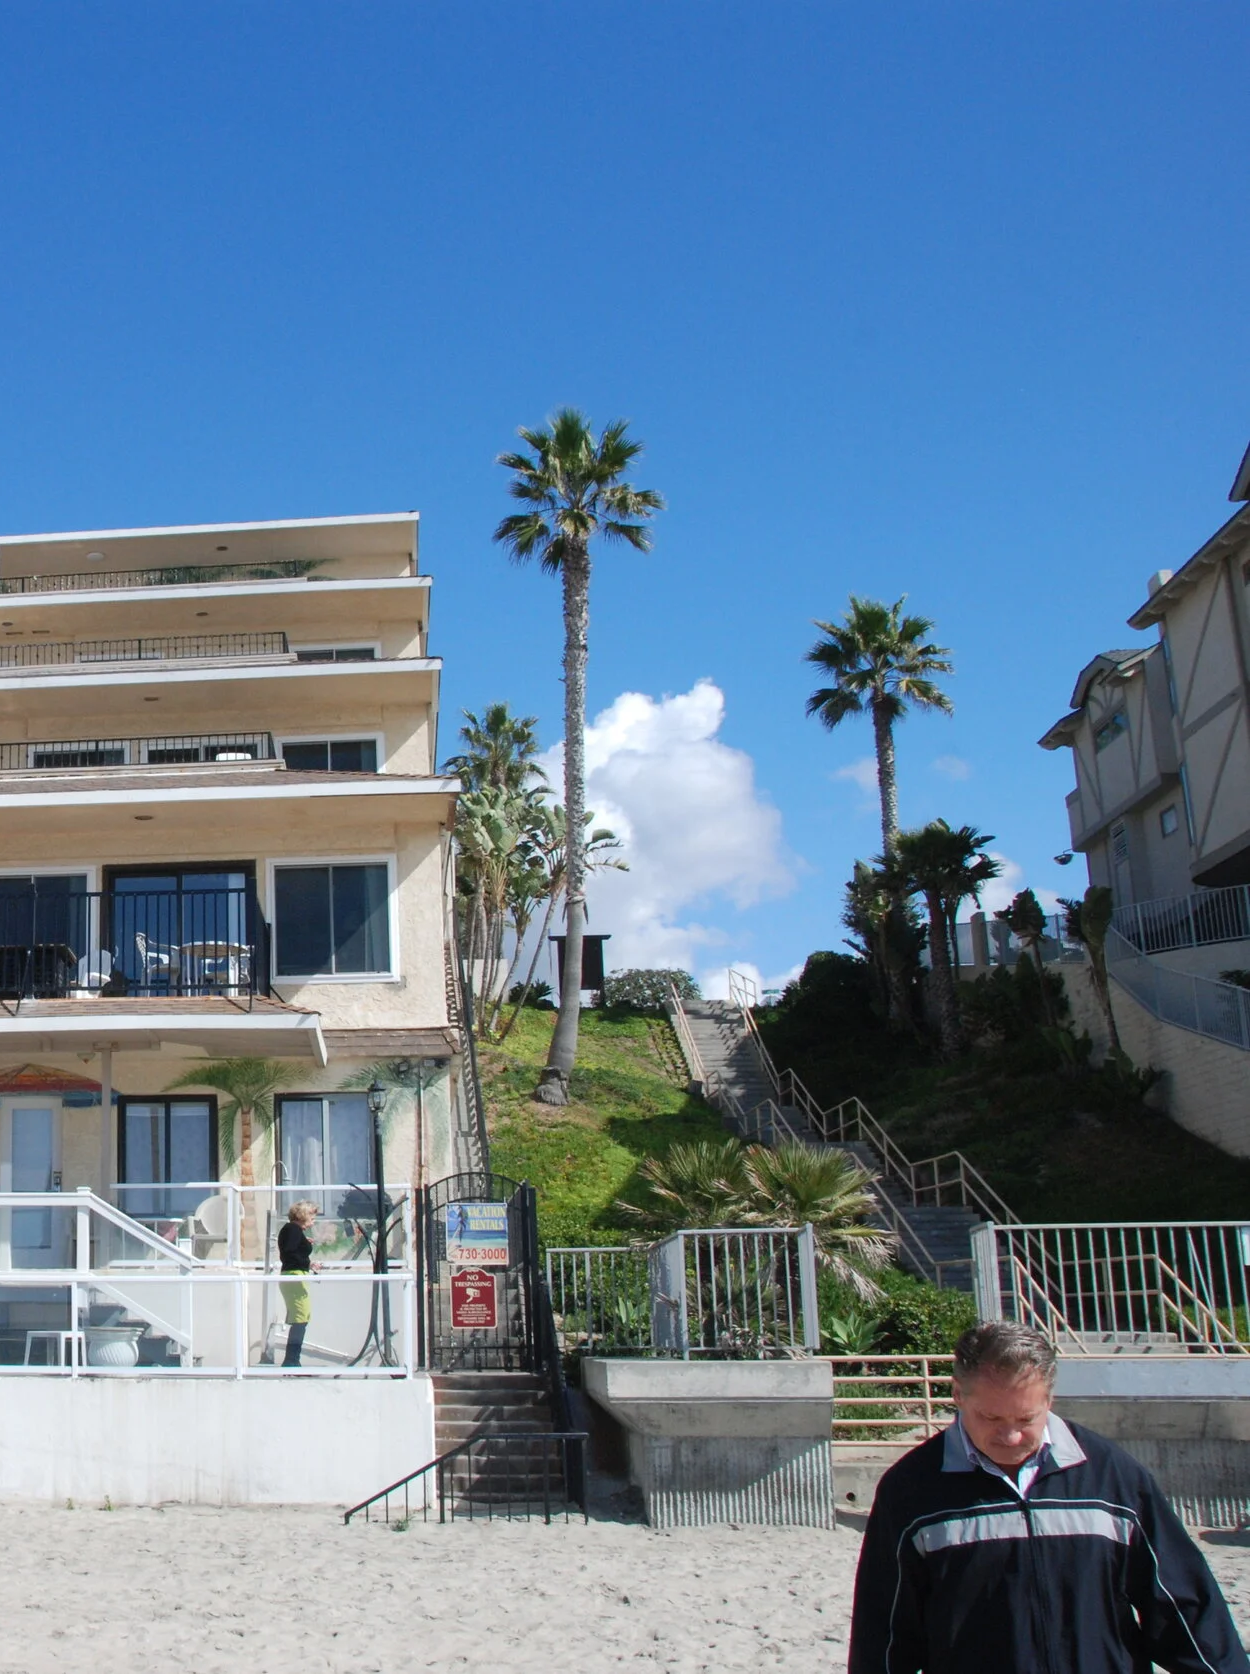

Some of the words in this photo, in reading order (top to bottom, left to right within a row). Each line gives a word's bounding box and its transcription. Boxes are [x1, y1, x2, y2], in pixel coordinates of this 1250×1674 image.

[467, 1205, 507, 1217] VACATION
[470, 1218, 504, 1230] RENTALS
[459, 1247, 506, 1260] 730-3000
